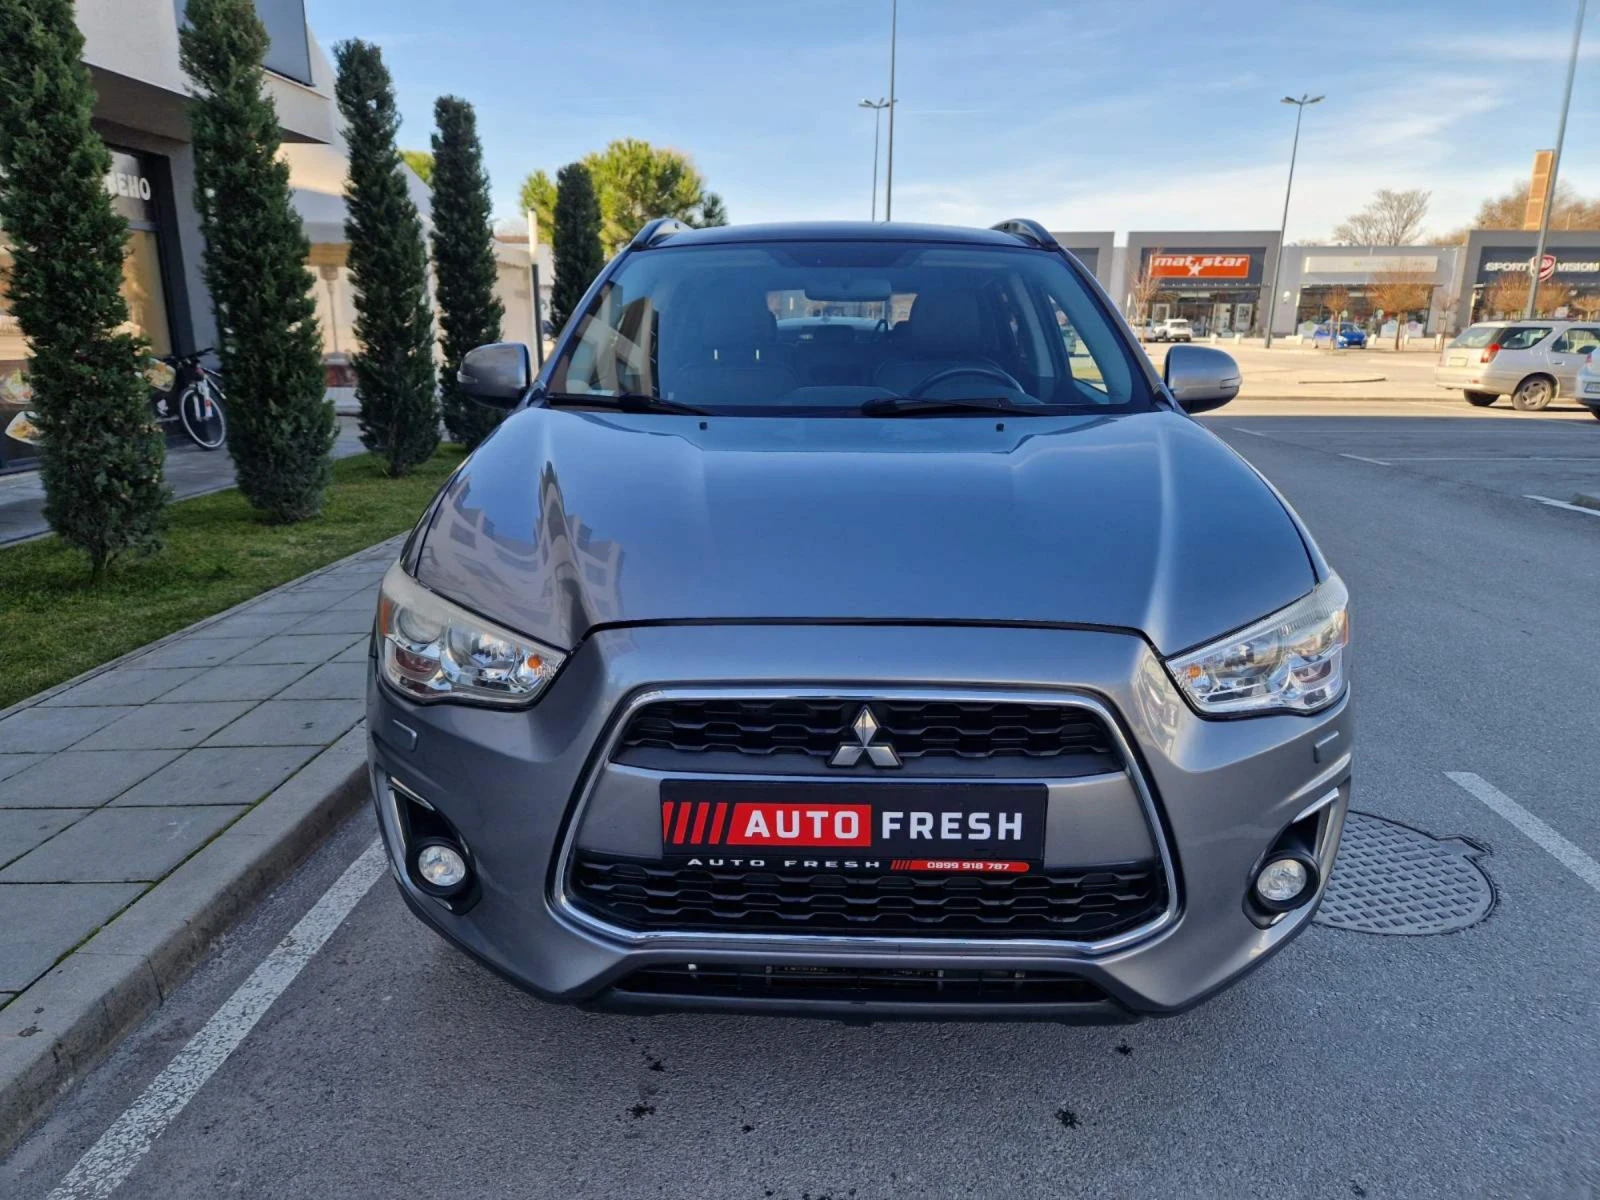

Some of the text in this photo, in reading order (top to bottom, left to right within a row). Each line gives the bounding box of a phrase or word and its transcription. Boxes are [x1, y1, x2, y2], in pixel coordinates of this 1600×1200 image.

[1485, 262, 1600, 272] SPORT VISION
[744, 809, 1023, 840] AUTO FRESH
[688, 858, 880, 868] AUTO FRESH
[927, 861, 959, 869] 0899
[963, 862, 984, 870] 918
